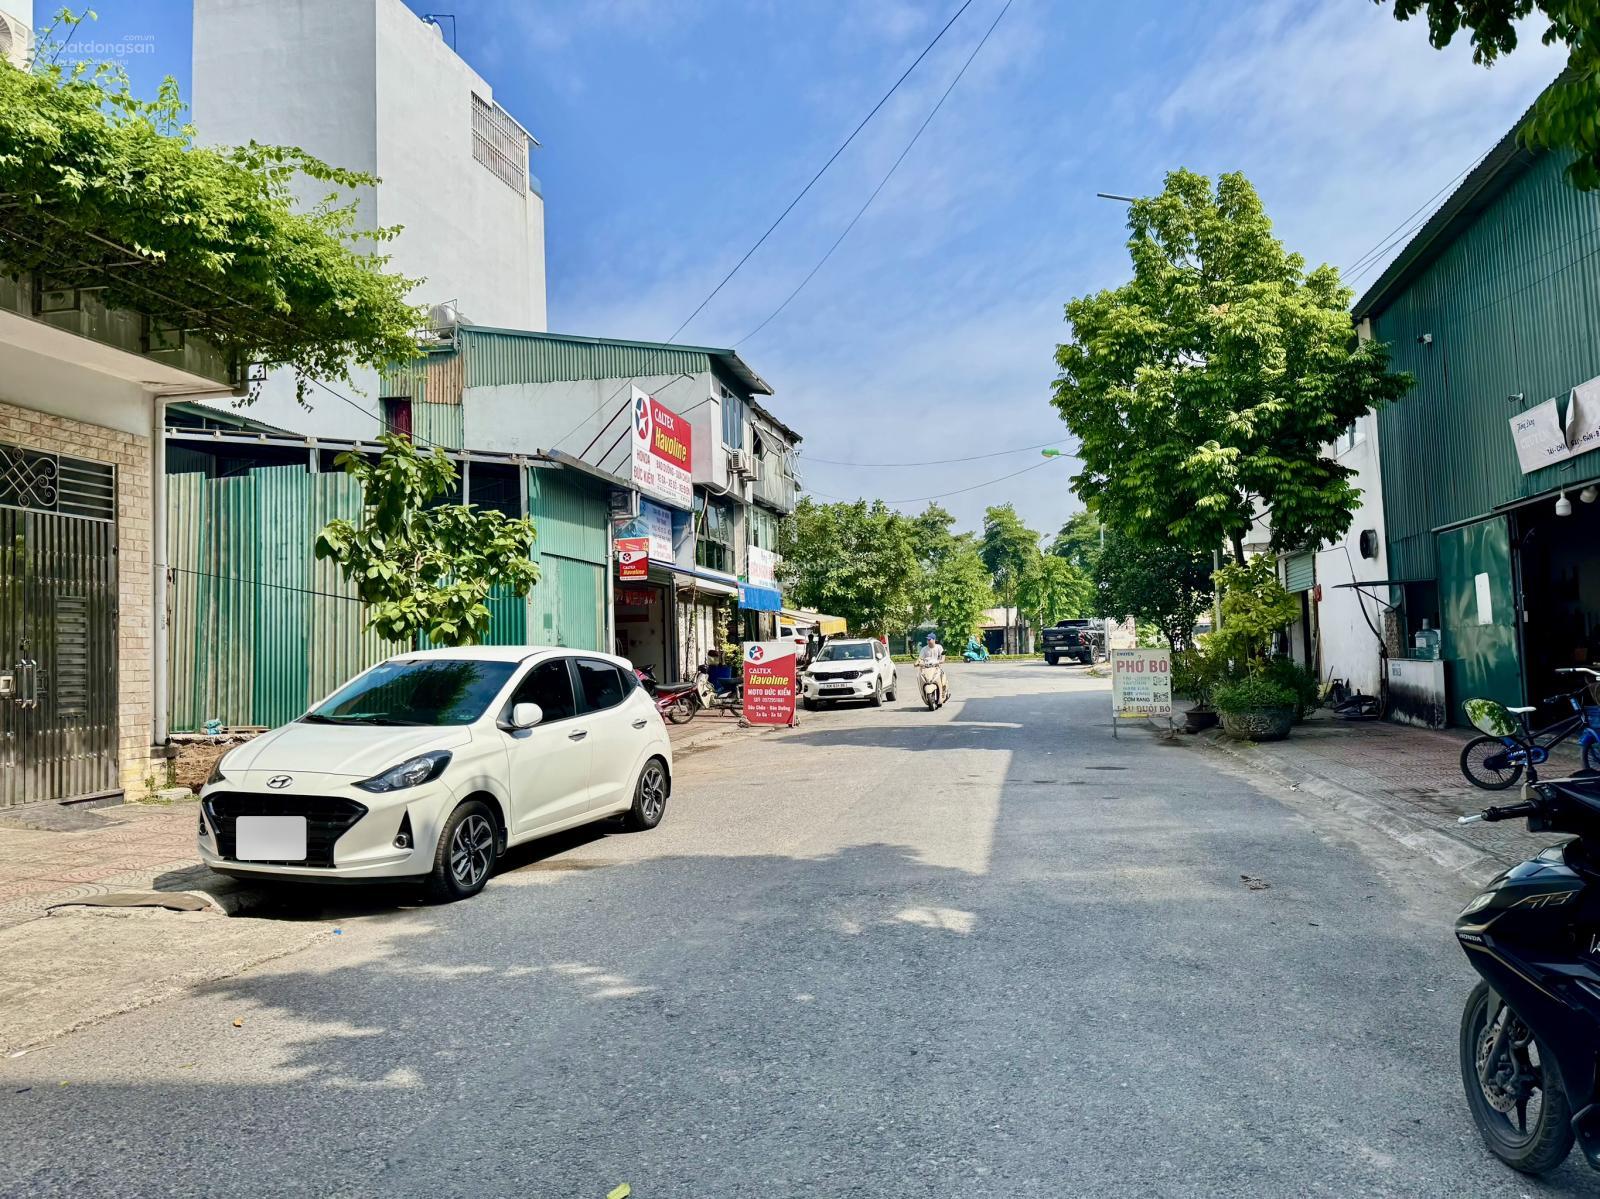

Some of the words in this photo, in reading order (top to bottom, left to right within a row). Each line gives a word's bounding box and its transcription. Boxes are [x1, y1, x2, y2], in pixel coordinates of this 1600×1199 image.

[654, 408, 675, 431] CALTEX
[655, 425, 687, 462] Havoline
[637, 448, 650, 465] HONDA
[1116, 655, 1145, 673] PHỞ
[1149, 657, 1168, 673] BÒ
[749, 675, 788, 685] Havoline
[1458, 933, 1482, 942] HONDA
